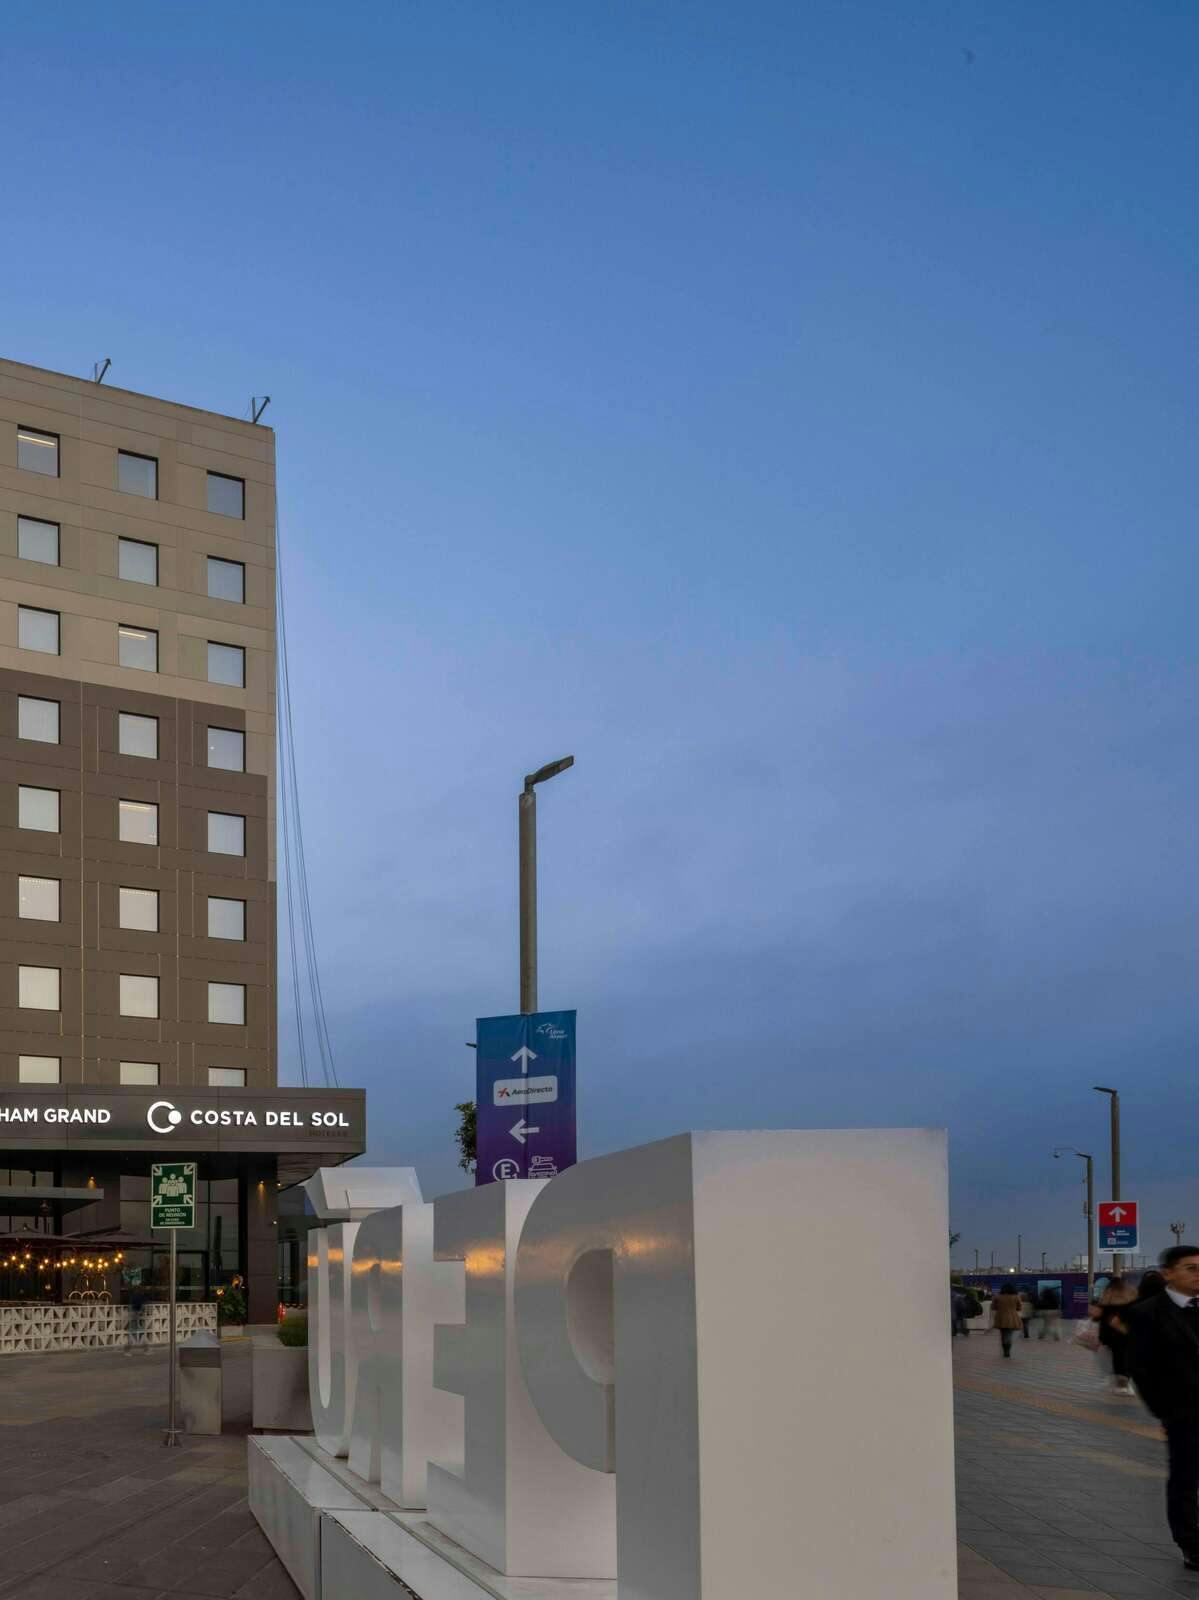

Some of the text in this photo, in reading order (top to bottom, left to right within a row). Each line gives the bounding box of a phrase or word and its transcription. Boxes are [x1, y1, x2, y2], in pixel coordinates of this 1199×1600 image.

[43, 1108, 111, 1124] GRAND
[190, 1110, 350, 1127] COSTA DEL SOL
